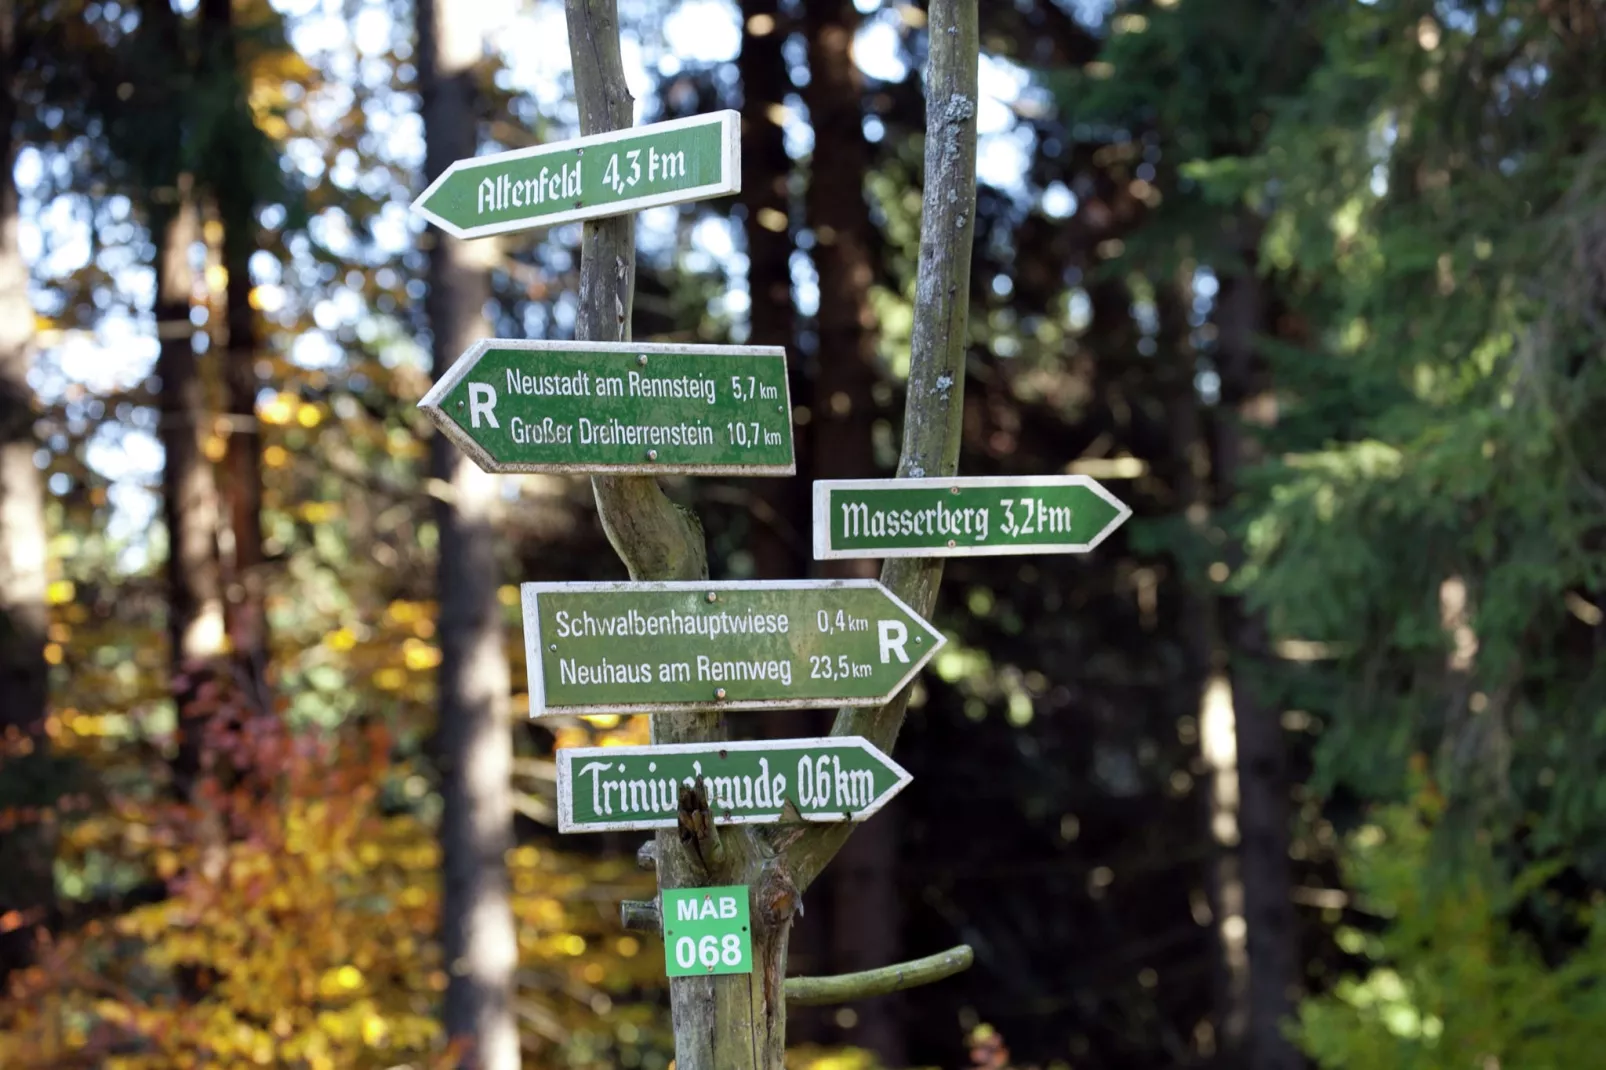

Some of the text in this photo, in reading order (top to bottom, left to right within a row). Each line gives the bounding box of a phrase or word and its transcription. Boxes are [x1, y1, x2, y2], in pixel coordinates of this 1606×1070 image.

[477, 146, 686, 215] Altenfeld 4,3 km
[506, 367, 778, 404] Neustadt am Rennsteig 5,7 km
[467, 381, 500, 430] R
[510, 416, 783, 449] Großer Dreiherrenstein 10,7 km
[841, 500, 990, 541] Masserberg
[555, 608, 790, 640] Schwalbenhauptwiese
[816, 609, 846, 635] 0,4
[877, 619, 910, 664] R
[559, 657, 653, 685] Neuhaus
[658, 662, 691, 683] am
[696, 655, 792, 686] Rennweg
[809, 654, 850, 682] 23,5
[676, 896, 738, 921] MAB
[675, 933, 742, 968] 068
